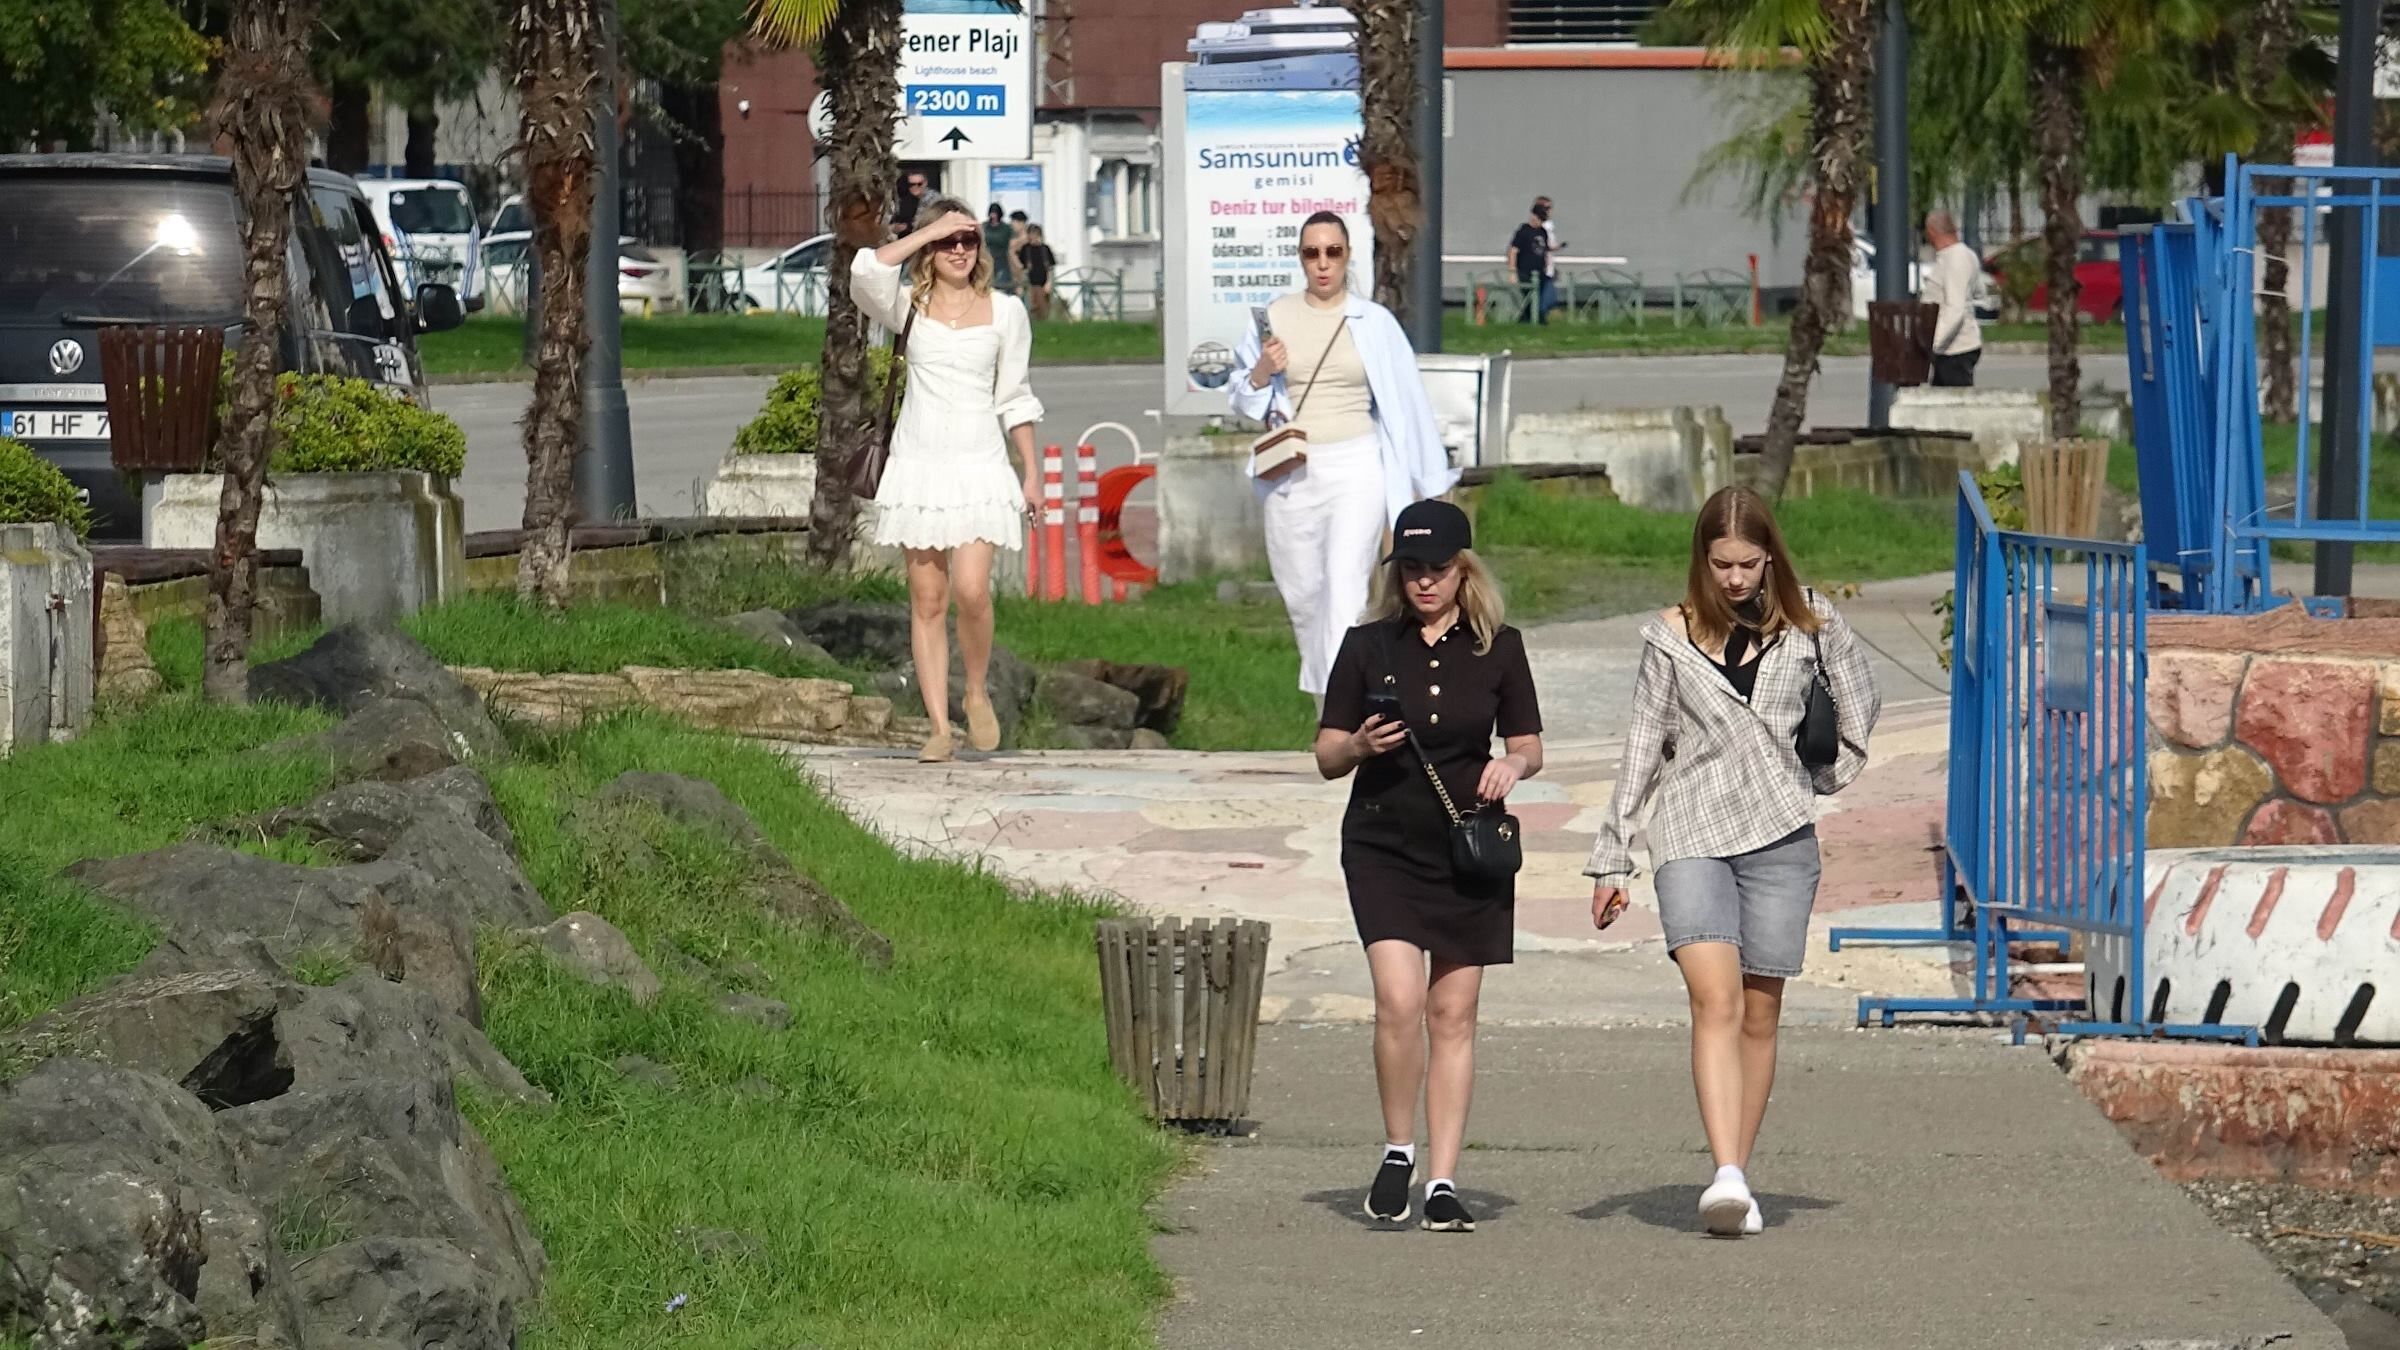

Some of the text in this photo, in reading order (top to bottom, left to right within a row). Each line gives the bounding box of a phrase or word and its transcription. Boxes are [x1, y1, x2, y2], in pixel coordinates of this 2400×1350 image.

[969, 28, 1018, 59] Plajı
[915, 66, 997, 77] Lighthouse beach
[914, 89, 999, 111] 2300 m
[1199, 149, 1339, 168] Samsunum
[1255, 174, 1314, 189] gemisi
[1210, 198, 1357, 215] Deniz tur bilgileri
[1212, 227, 1236, 238] TAM
[14, 414, 36, 435] 61
[51, 414, 82, 435] HF
